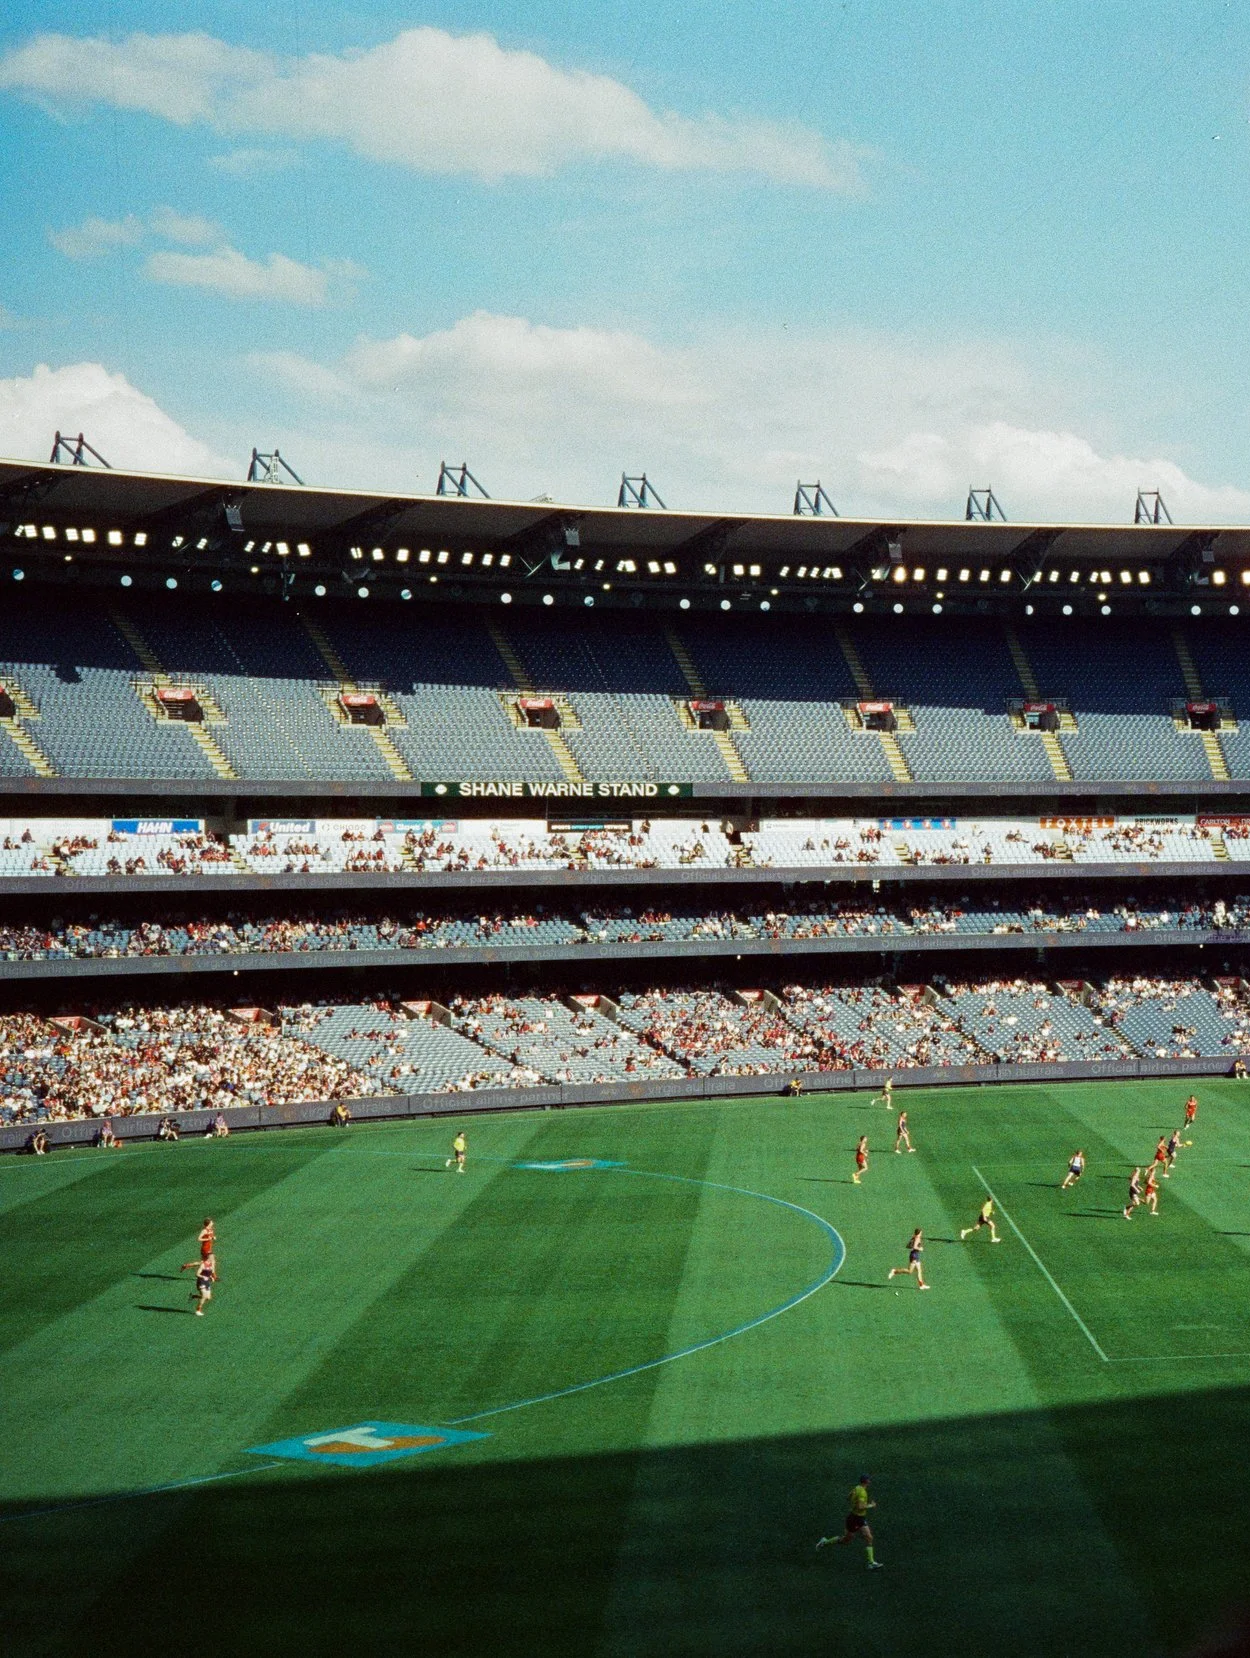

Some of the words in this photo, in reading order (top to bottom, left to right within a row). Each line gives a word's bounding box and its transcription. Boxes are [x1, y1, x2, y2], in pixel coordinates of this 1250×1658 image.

[458, 783, 522, 797] SHANE
[527, 783, 593, 797] WARNE
[597, 783, 657, 797] STAND
[137, 821, 173, 834] HAHN
[269, 821, 311, 833] United
[1046, 818, 1109, 828] FOXTEL
[1091, 1062, 1136, 1073] Official
[1181, 1060, 1228, 1071] partner
